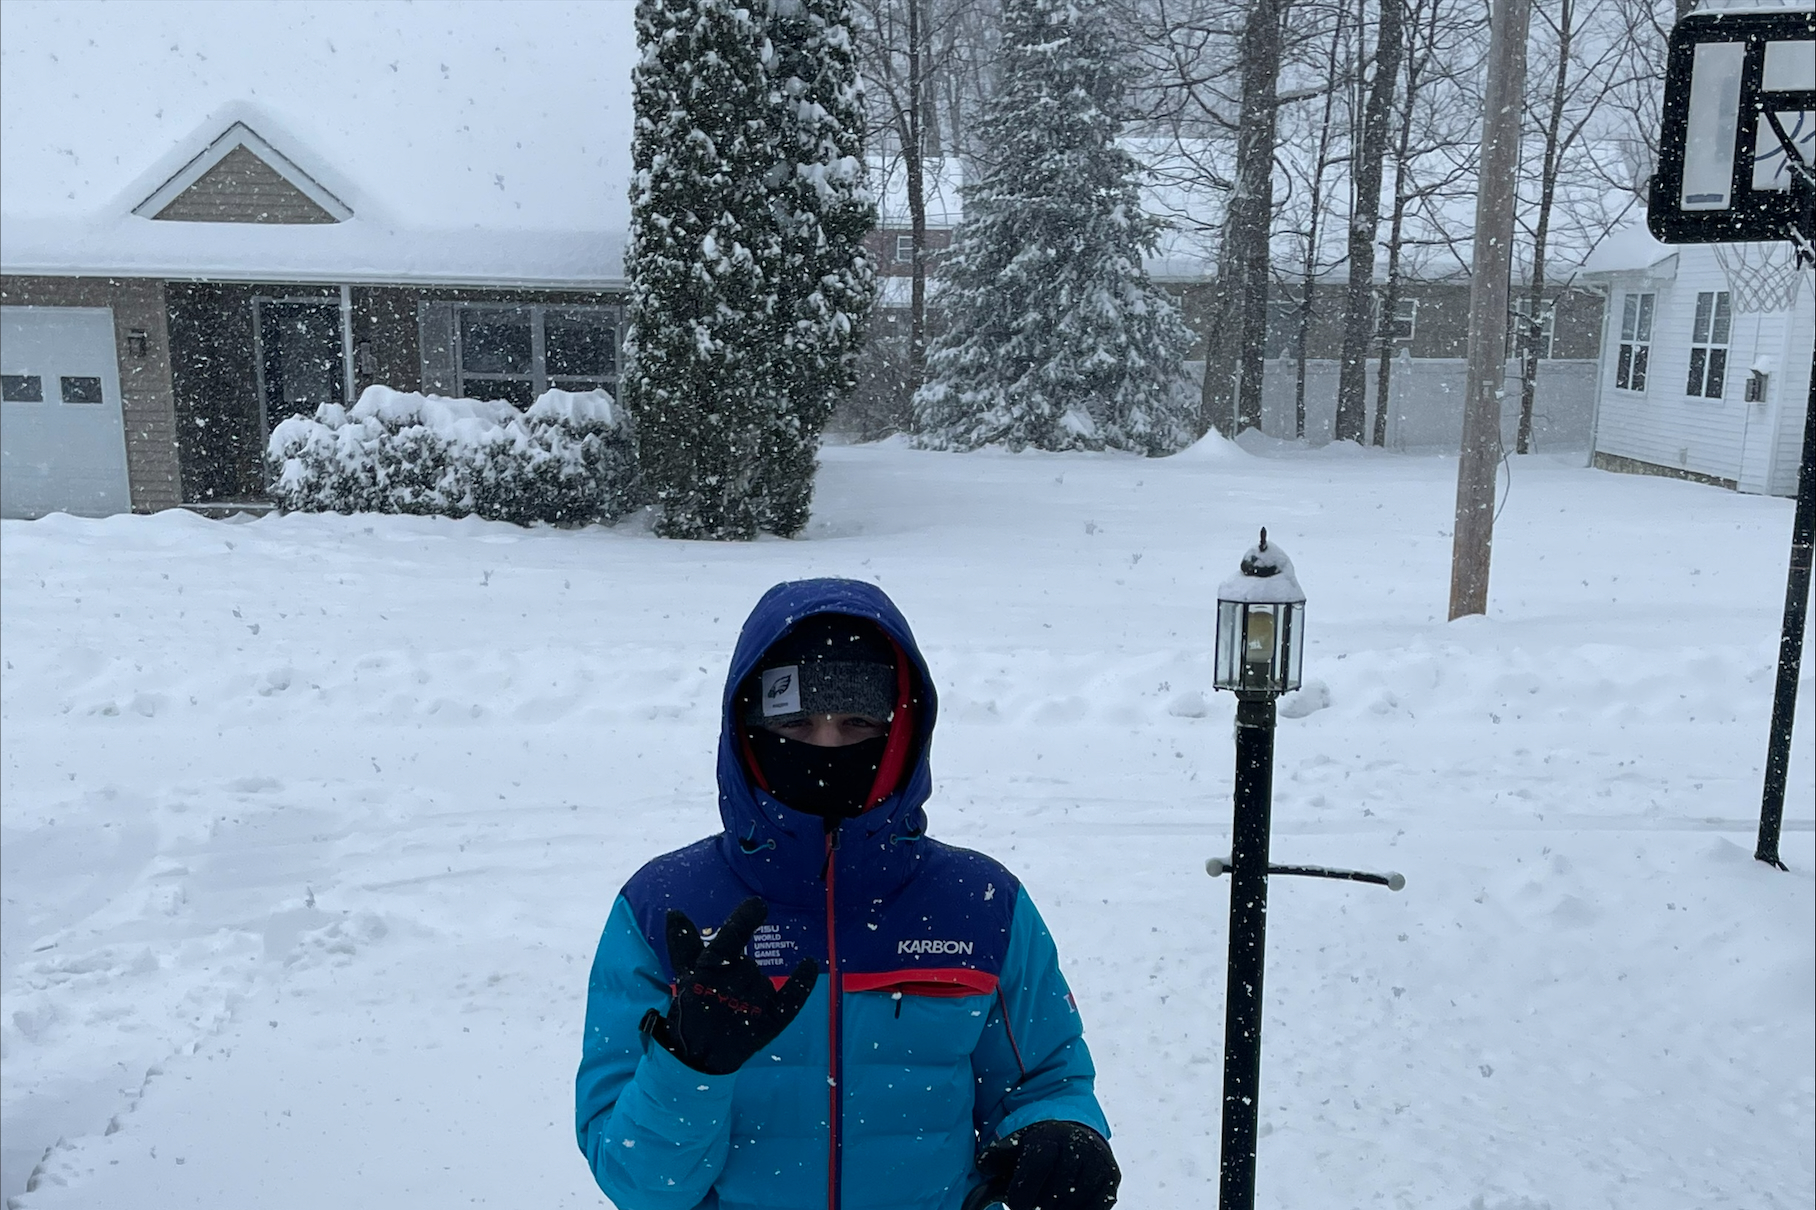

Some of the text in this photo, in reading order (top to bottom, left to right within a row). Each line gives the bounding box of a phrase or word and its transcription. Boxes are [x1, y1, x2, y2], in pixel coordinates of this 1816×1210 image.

[753, 933, 782, 942] WORLD
[753, 941, 796, 950] UNIVERSITY
[897, 940, 974, 955] KARBON
[754, 949, 781, 959] GAMES
[755, 958, 785, 967] WINTER
